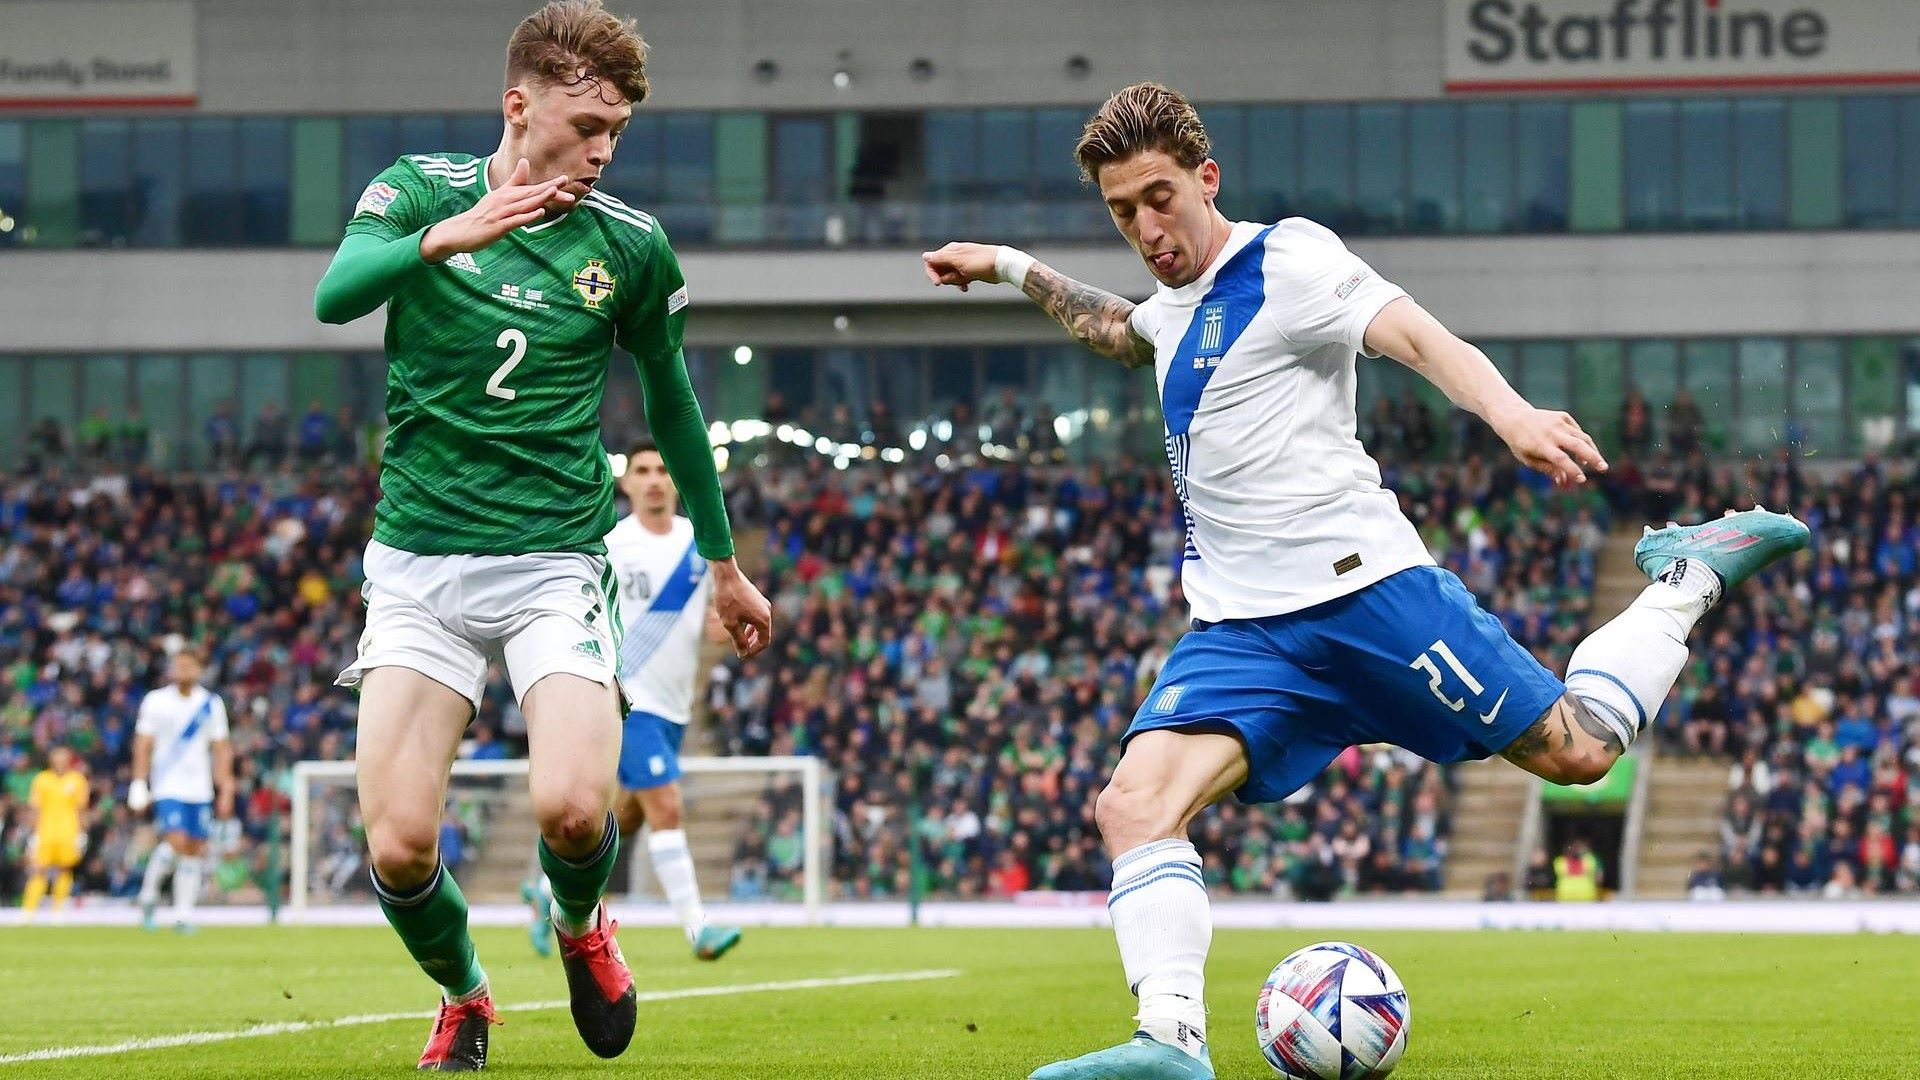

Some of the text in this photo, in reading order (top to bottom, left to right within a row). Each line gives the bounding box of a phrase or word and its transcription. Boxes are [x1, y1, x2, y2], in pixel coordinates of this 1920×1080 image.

[1466, 0, 1829, 64] Staffline
[485, 328, 527, 401] 2
[624, 570, 651, 600] 20
[571, 644, 606, 663] adidas
[1409, 639, 1485, 712] 21
